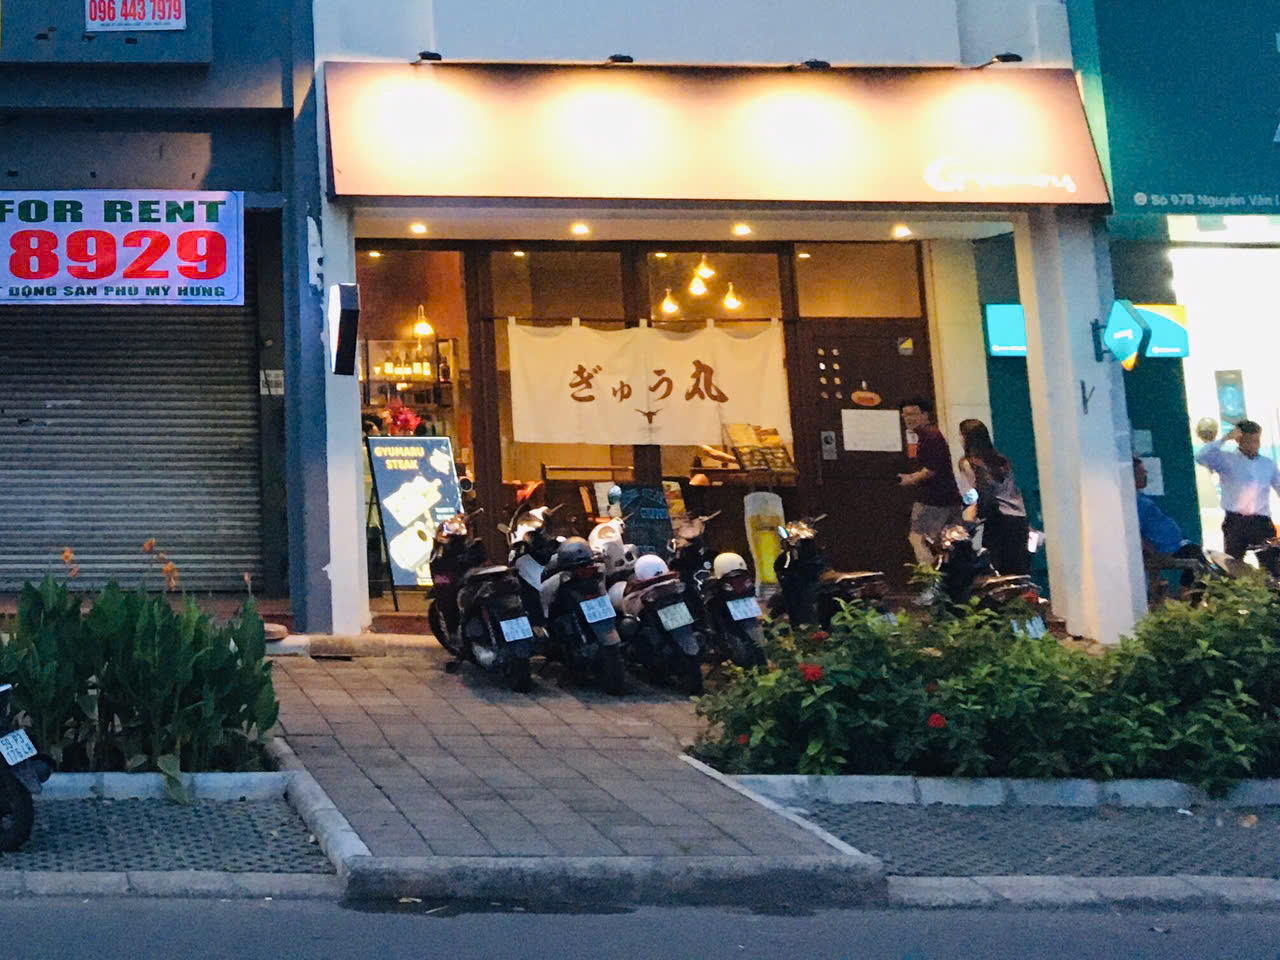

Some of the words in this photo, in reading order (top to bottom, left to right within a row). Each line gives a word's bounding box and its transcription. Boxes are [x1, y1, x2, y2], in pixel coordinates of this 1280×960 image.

[89, 0, 116, 22] 096
[103, 200, 226, 223] RENT
[9, 229, 227, 280] 8929
[569, 359, 729, 404] ぎゅう丸
